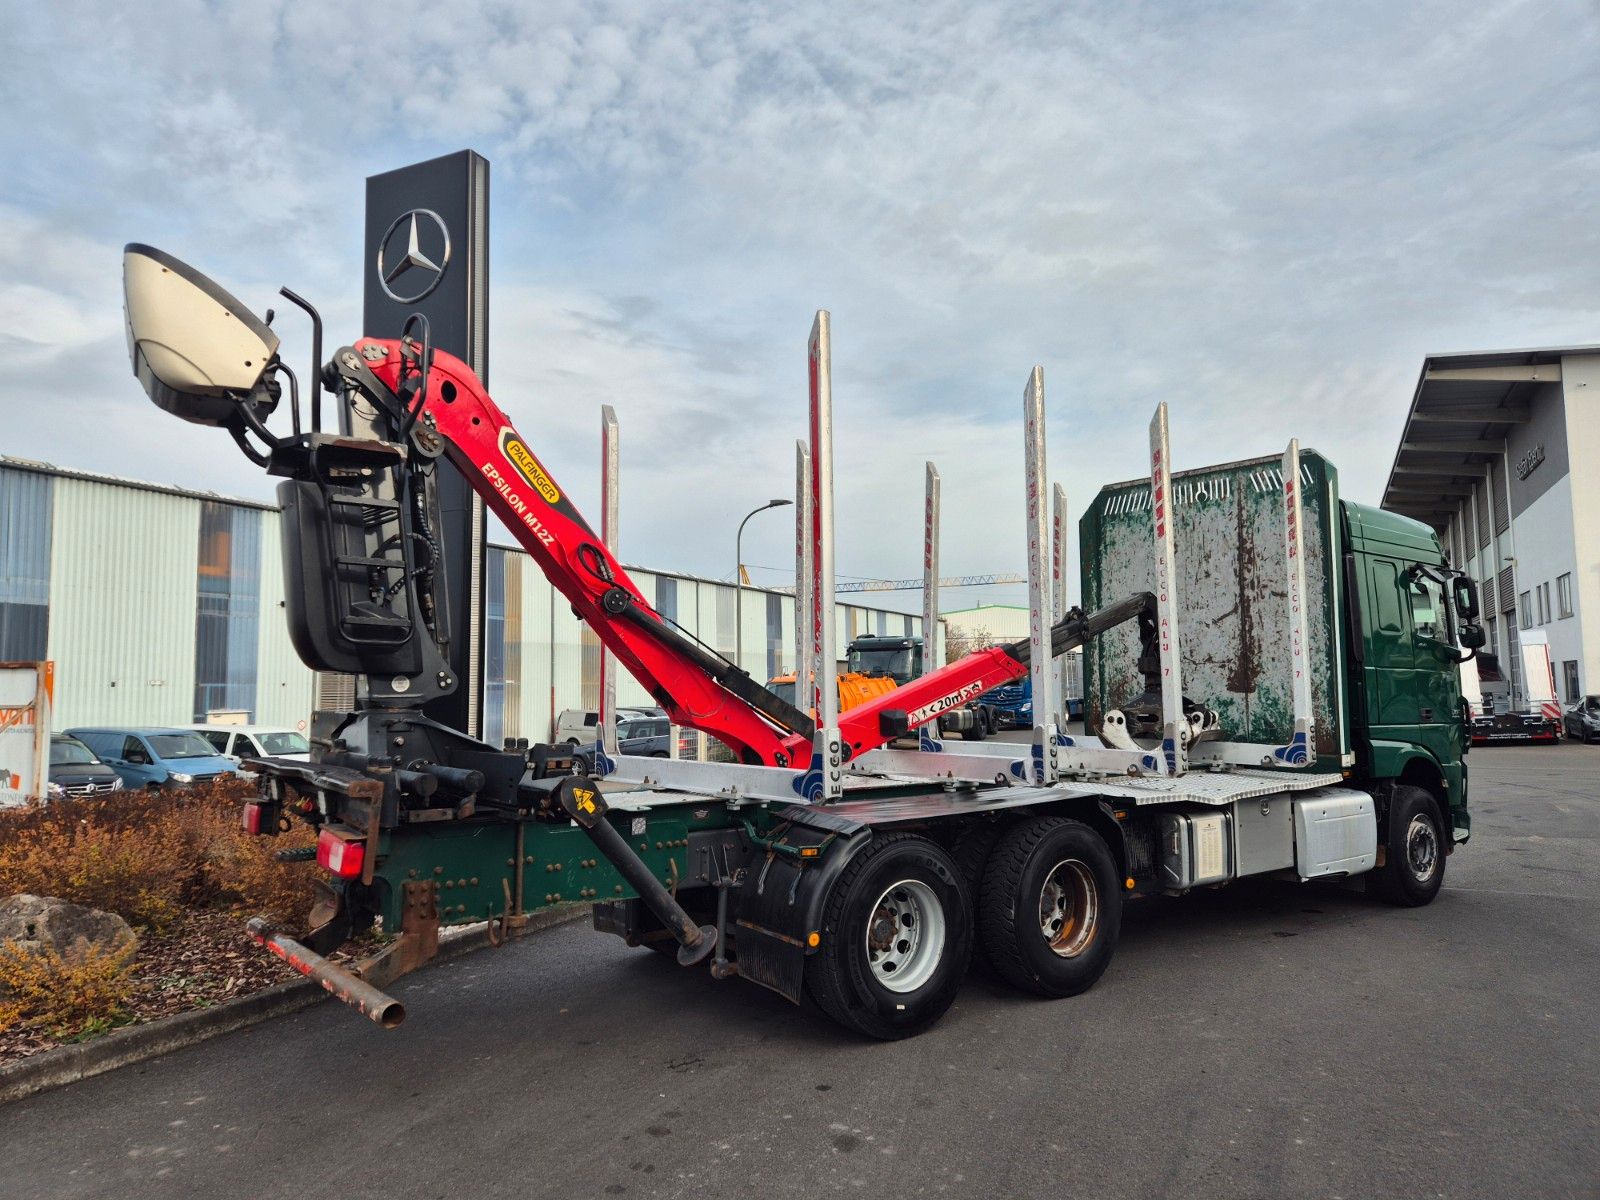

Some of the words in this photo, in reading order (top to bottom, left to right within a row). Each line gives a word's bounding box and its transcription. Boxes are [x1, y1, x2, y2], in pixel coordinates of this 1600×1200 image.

[481, 462, 527, 514] EPSILON
[523, 512, 555, 547] M12Z
[509, 443, 556, 500] PALFINGER
